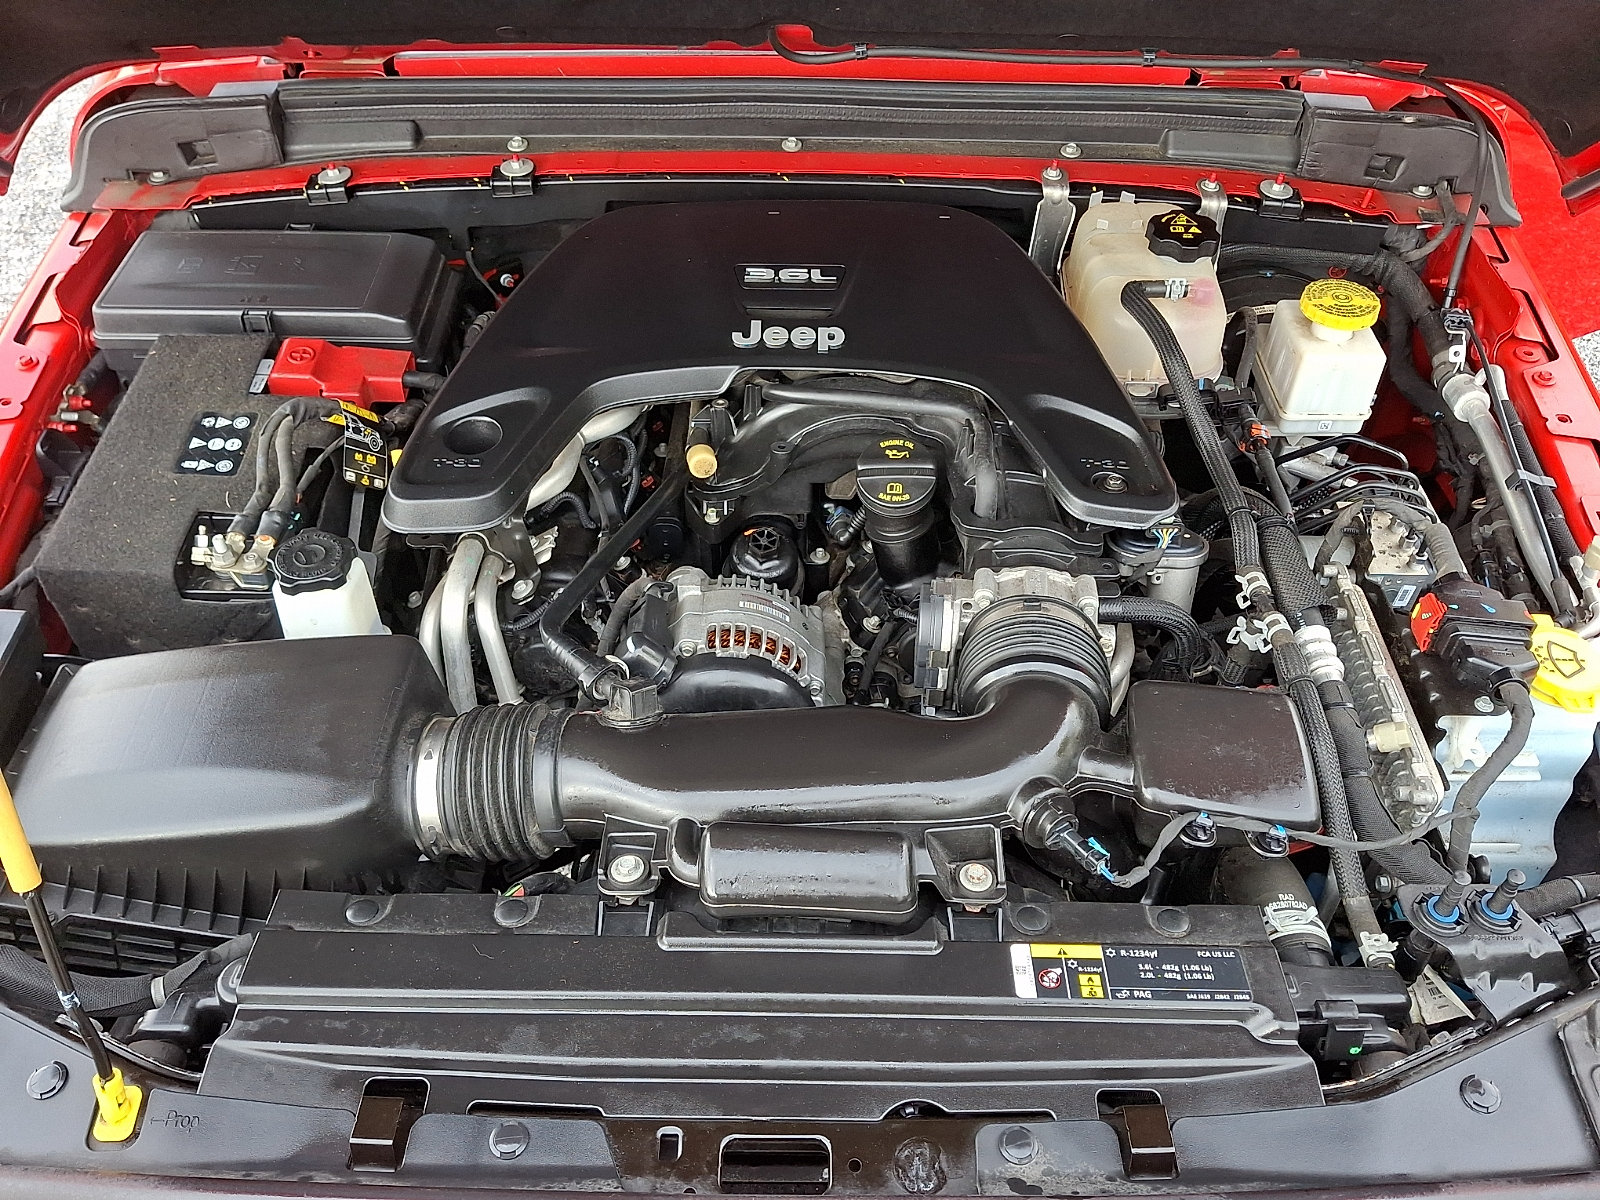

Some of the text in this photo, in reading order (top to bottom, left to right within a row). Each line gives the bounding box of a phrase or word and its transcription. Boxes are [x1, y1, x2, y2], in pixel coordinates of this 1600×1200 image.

[744, 268, 837, 283] 3.6L
[732, 320, 845, 354] Jeep
[880, 440, 915, 450] ENGINE OIL
[1278, 893, 1295, 901] RAD
[1120, 950, 1158, 959] R-1234yf
[1133, 990, 1152, 999] PAG
